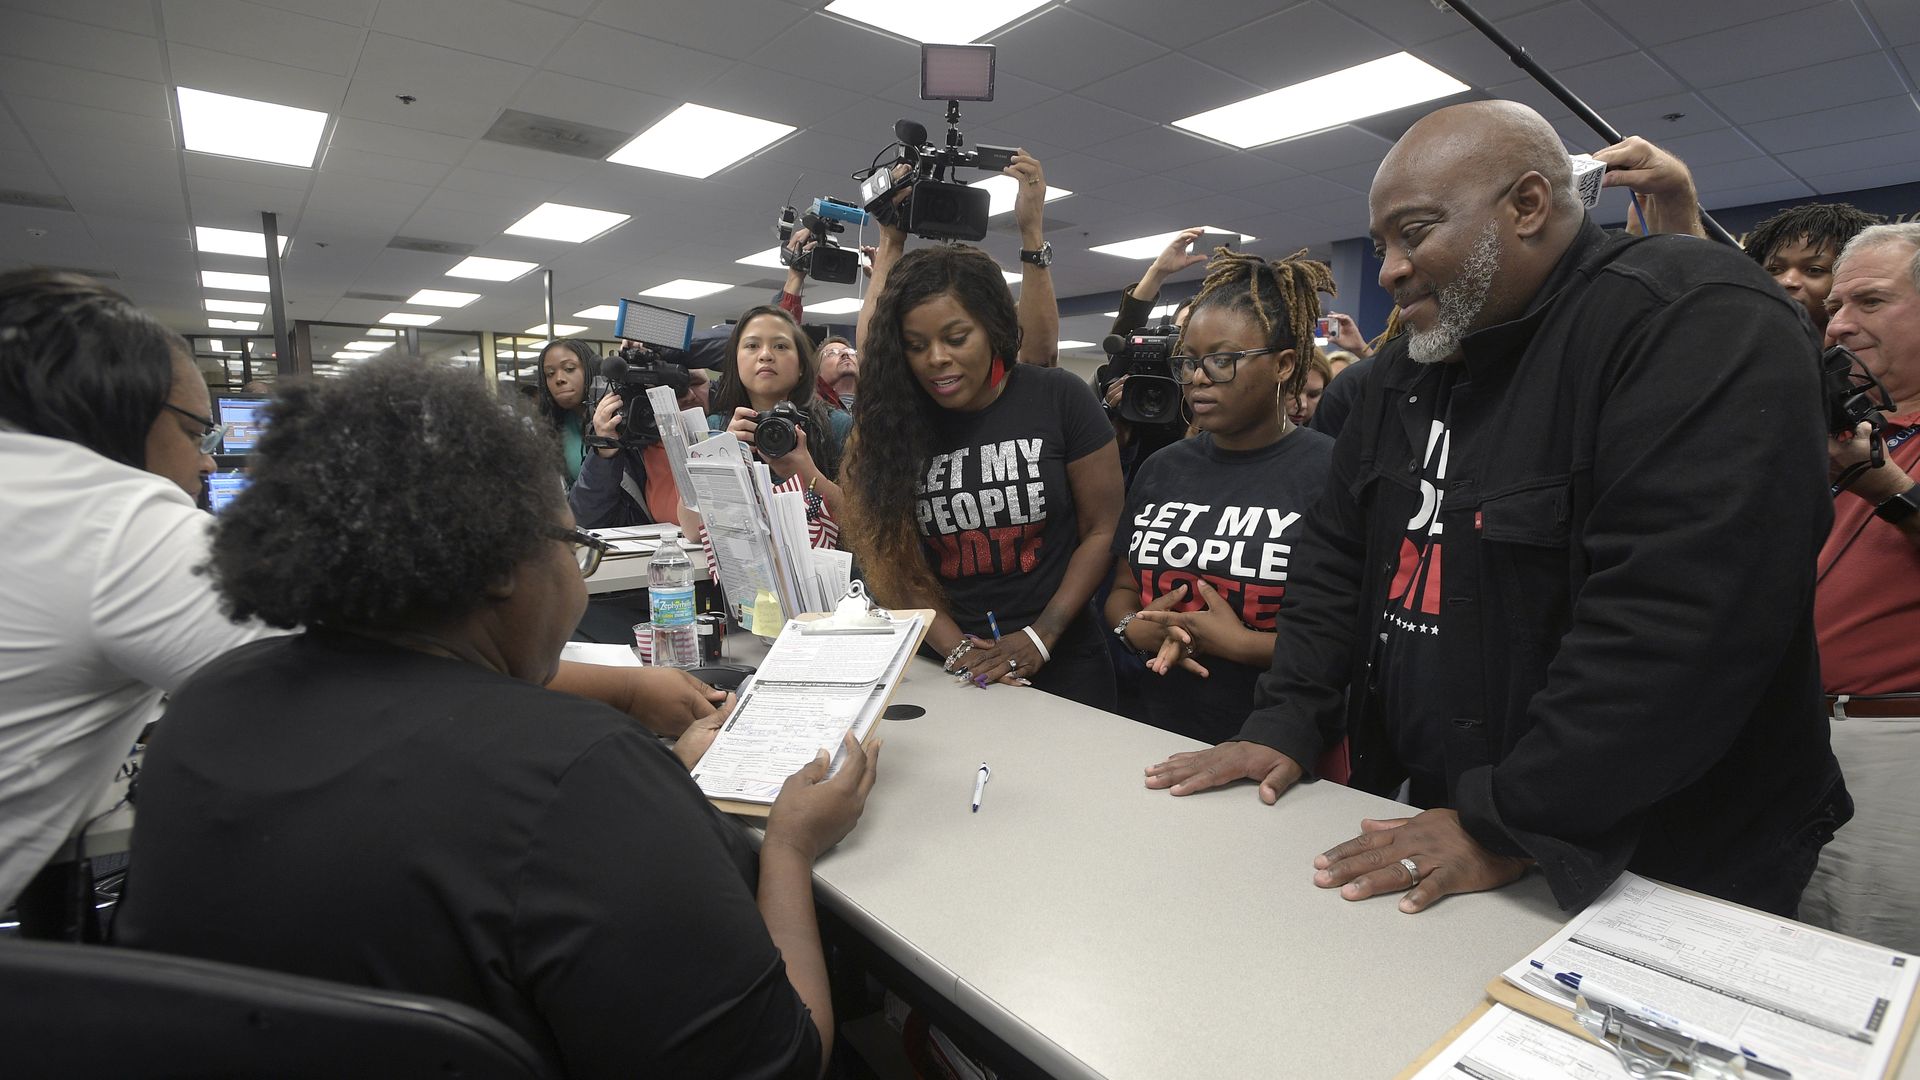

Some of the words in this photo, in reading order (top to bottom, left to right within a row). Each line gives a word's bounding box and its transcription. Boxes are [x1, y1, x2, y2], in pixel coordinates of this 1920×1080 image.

[915, 447, 970, 495] LET
[980, 438, 1043, 483] MY
[915, 481, 1047, 536] PEOPLE
[1134, 502, 1211, 533] LET
[1214, 506, 1302, 538] MY
[1128, 530, 1291, 581] PEOPLE
[660, 600, 692, 611] Zephyrh
